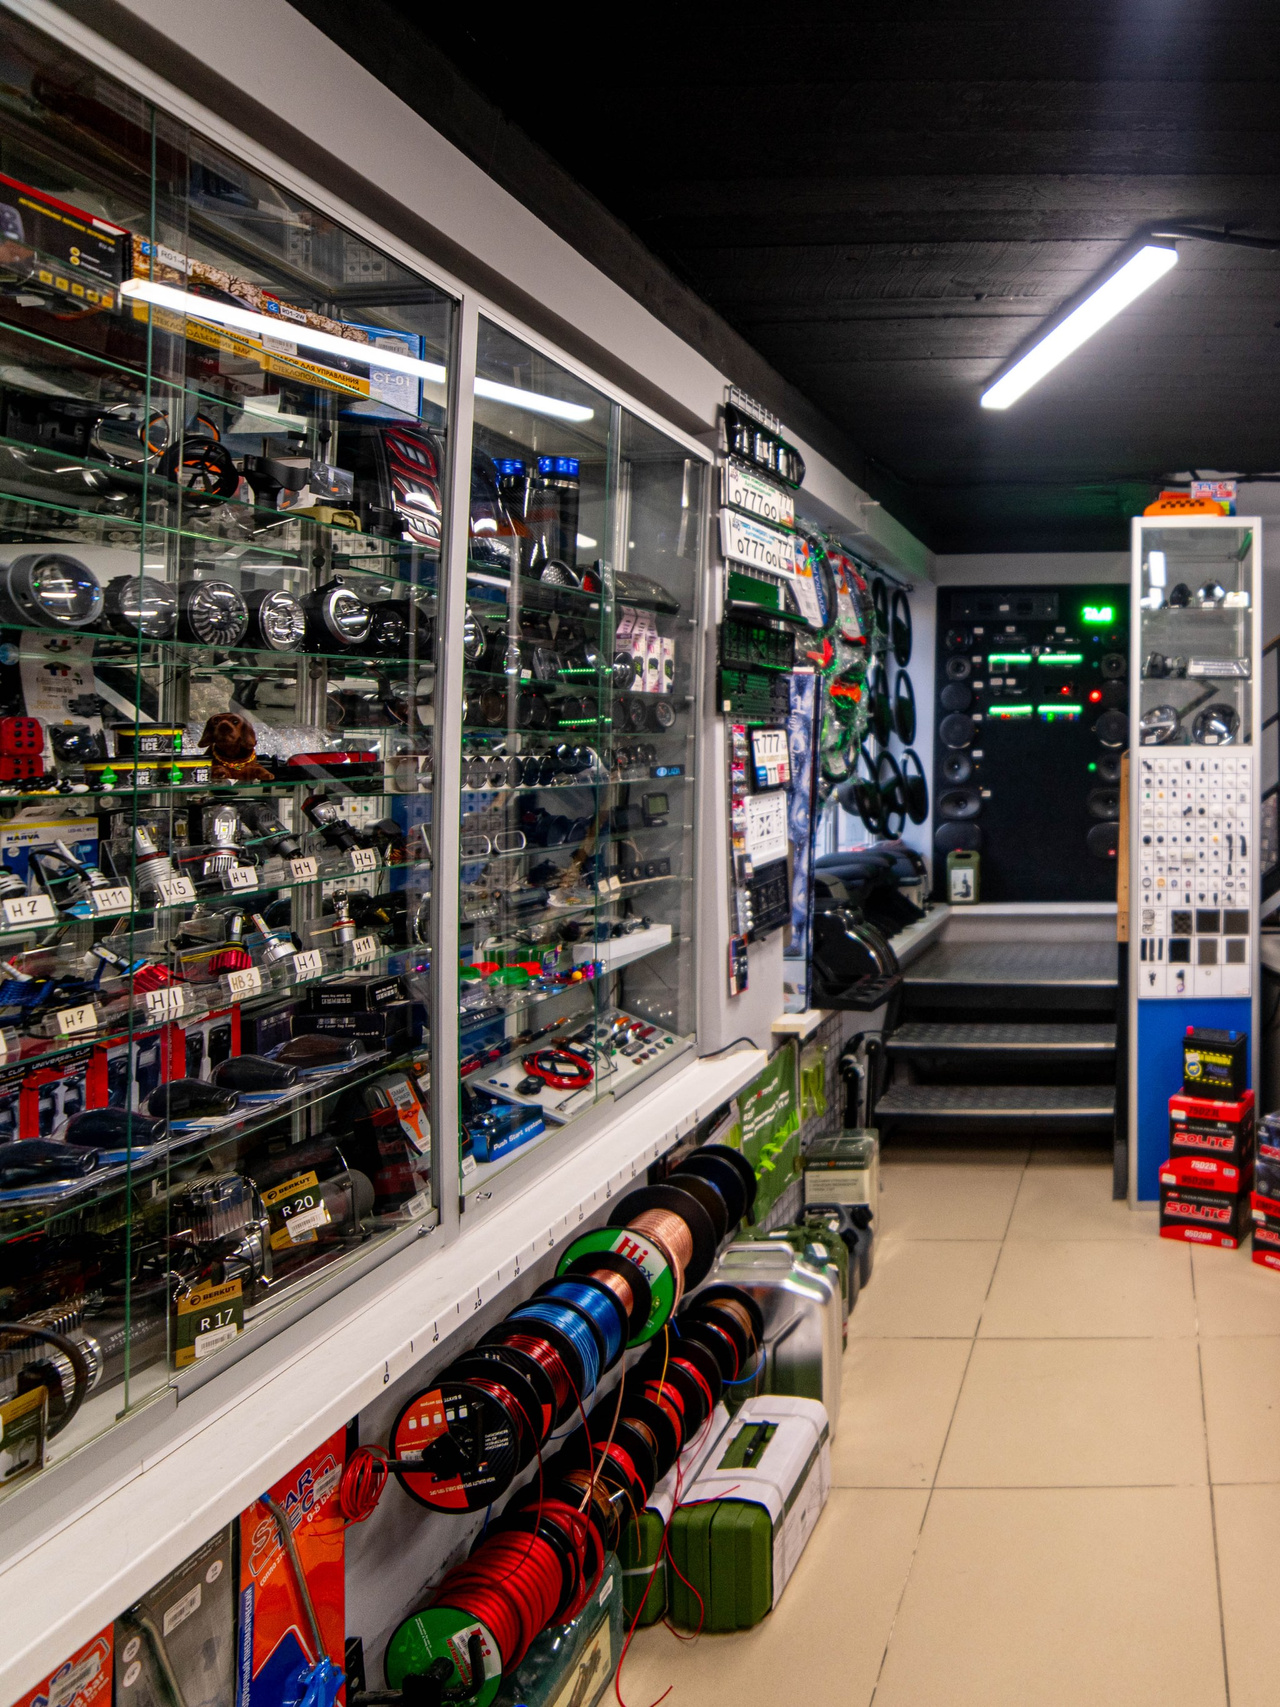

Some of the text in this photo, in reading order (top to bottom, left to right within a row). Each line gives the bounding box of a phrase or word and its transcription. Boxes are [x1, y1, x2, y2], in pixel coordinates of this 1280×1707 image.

[141, 742, 159, 751] ICE
[136, 776, 150, 785] ICE
[196, 773, 209, 782] ICE
[6, 833, 40, 842] NARVA
[355, 852, 373, 864] H4
[294, 862, 312, 875] H4
[232, 871, 249, 883] H4
[165, 881, 187, 897] H15
[99, 890, 127, 907] H11
[356, 938, 371, 952] H11
[297, 957, 316, 970] H1
[31, 1052, 74, 1070] UNIVERSAL
[75, 1047, 91, 1058] CLIP
[8, 1066, 25, 1078] CLIP
[390, 1084, 409, 1098] SMART
[493, 1118, 543, 1151] Push Start system
[1173, 1132, 1235, 1151] SOLITE
[1191, 1160, 1218, 1172] 75D23L
[278, 1176, 311, 1194] BERKUT
[282, 1195, 315, 1218] R 20
[1164, 1201, 1231, 1223] SOLITE
[615, 1235, 648, 1266] Hi
[203, 1285, 237, 1300] BERKUT
[201, 1308, 235, 1331] R 17
[83, 1671, 105, 1698] bar
